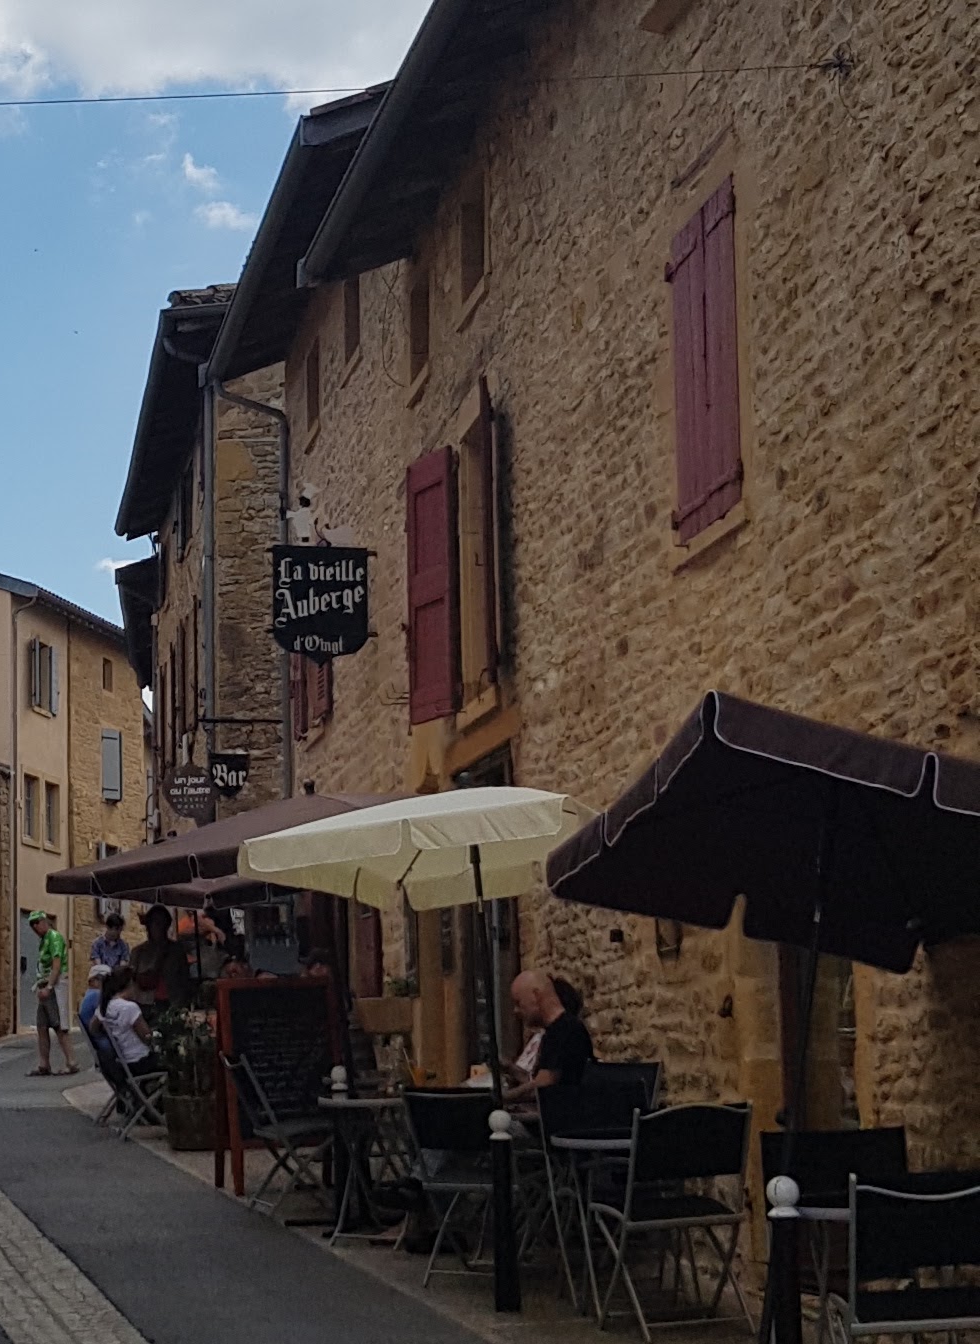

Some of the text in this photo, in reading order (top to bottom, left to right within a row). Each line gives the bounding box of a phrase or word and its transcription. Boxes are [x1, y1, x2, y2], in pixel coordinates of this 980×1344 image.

[278, 557, 365, 588] La vieille
[274, 585, 365, 628] Auberge
[174, 775, 206, 786] un jour
[212, 763, 247, 787] Bar
